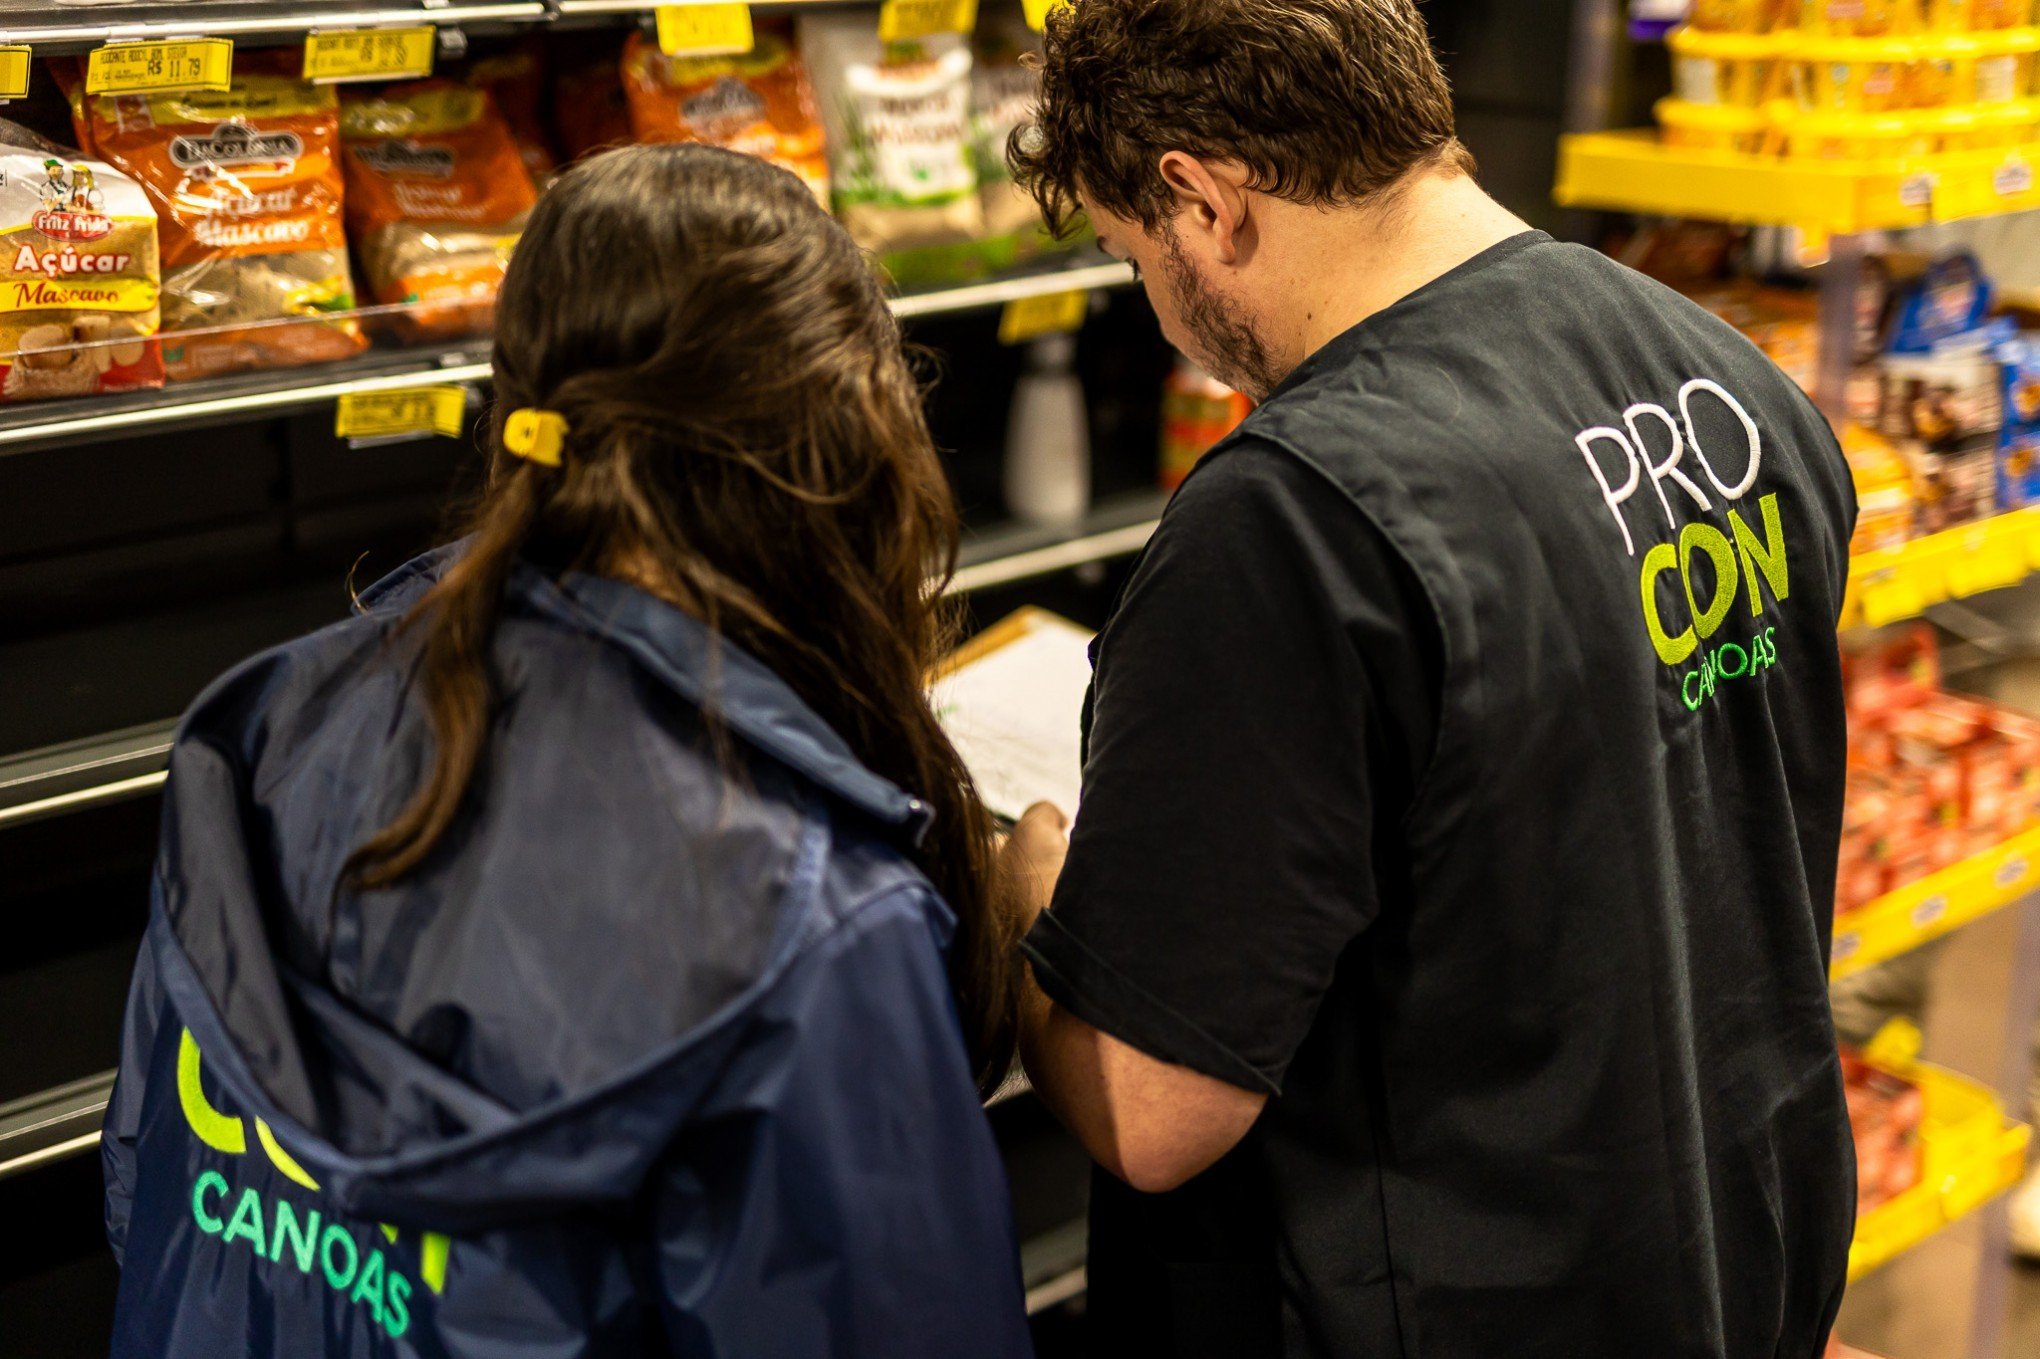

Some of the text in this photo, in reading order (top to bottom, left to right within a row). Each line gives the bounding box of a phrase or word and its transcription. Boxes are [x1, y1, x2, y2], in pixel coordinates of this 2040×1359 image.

[147, 60, 162, 76] R$
[13, 282, 119, 308] Mascavo
[14, 245, 129, 277] Açúcar
[1574, 378, 1762, 556] PRO
[1640, 492, 1789, 666] CON
[1681, 626, 1777, 711] CANOAS
[192, 1170, 412, 1339] CANOAS
